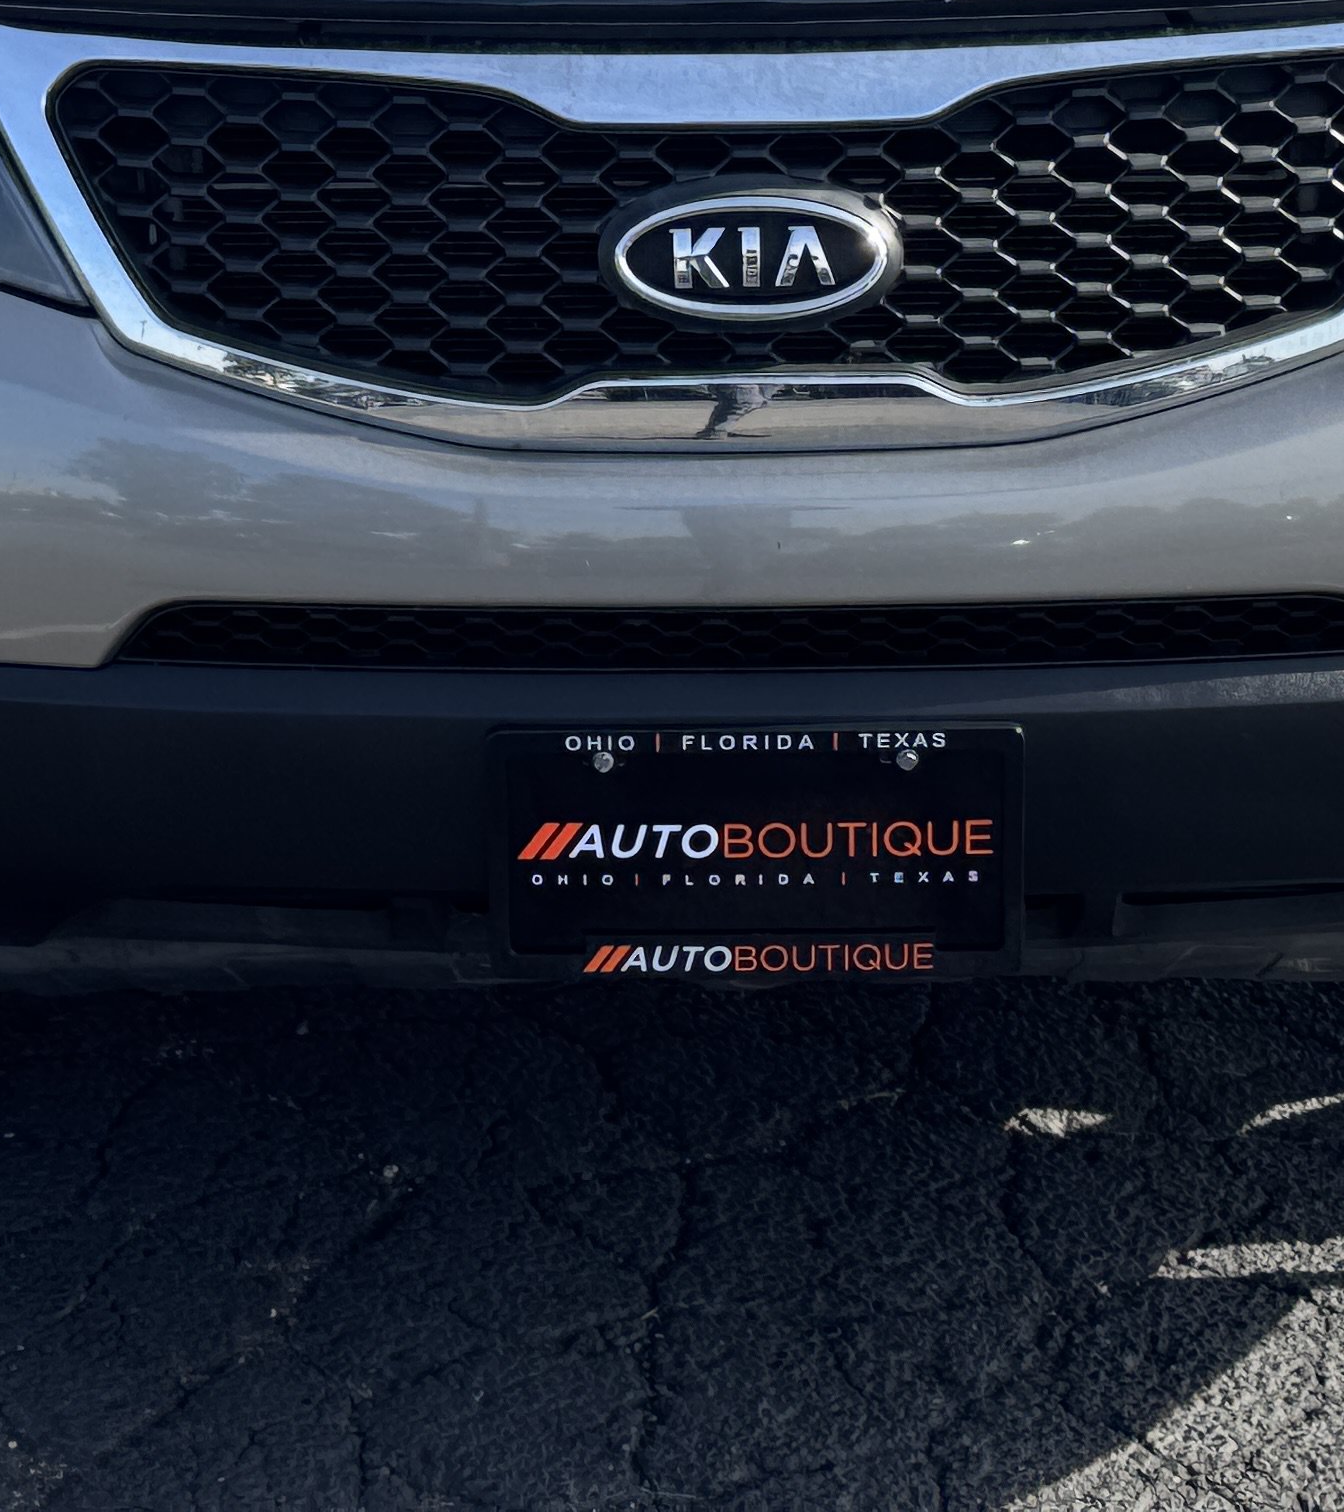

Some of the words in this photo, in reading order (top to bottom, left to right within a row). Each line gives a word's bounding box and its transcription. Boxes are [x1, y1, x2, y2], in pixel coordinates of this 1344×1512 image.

[669, 225, 836, 289] KIA
[564, 734, 636, 752] OHIO
[682, 733, 815, 751] FLORIDA
[858, 731, 947, 749] TEXAS
[568, 819, 994, 860] AUTOBOUTIQUE
[531, 873, 614, 886] OHIO
[662, 872, 815, 885] FLORIDA
[869, 870, 979, 883] TEXAS
[620, 942, 934, 972] AUTOBOUTIQUE
